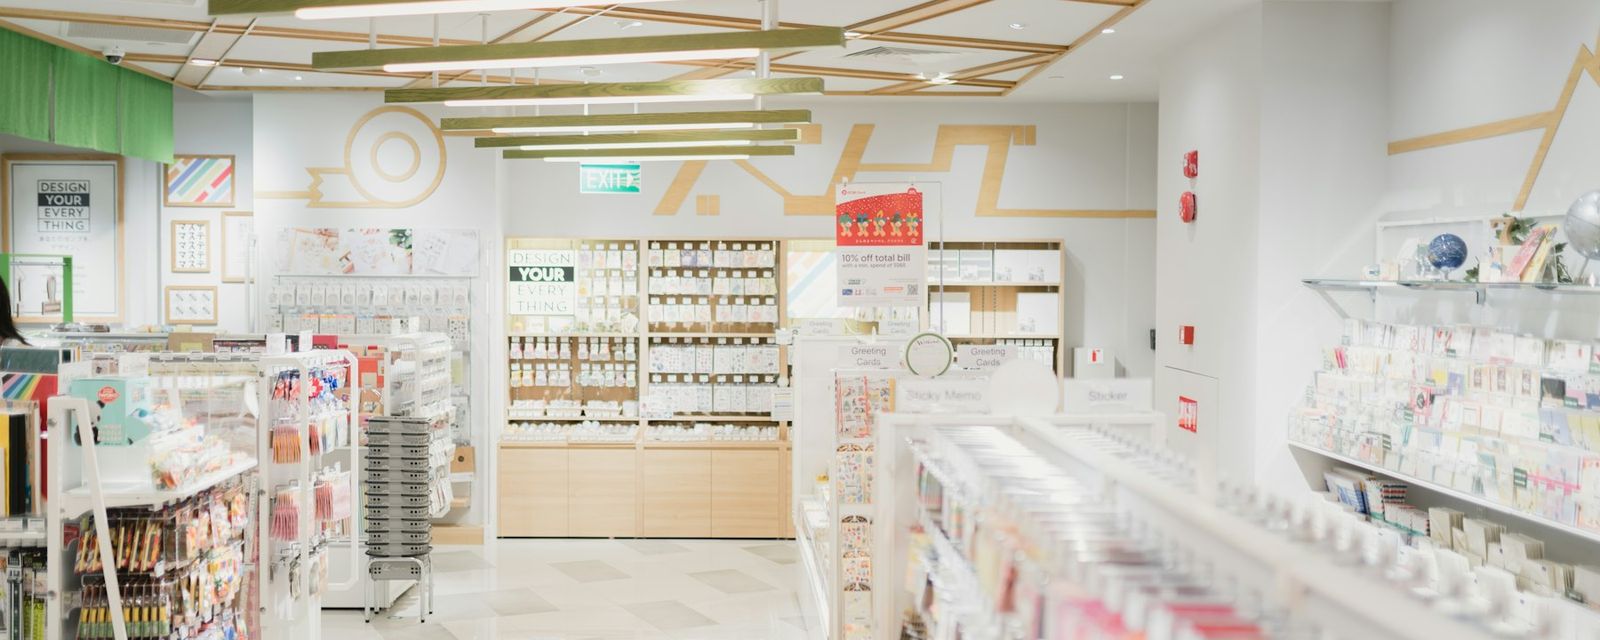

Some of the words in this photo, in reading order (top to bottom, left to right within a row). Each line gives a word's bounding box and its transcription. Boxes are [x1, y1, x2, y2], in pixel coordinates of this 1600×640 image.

[587, 170, 621, 189] EXIT
[41, 182, 87, 192] DESIGN
[45, 194, 82, 206] YOUR
[44, 207, 84, 217] EVERY
[43, 220, 85, 230] THING
[513, 252, 570, 264] DESIGN
[842, 254, 859, 262] 10%
[861, 254, 873, 262] off
[875, 254, 895, 262] total
[897, 253, 911, 262] bill
[518, 267, 565, 281] YOUR
[517, 284, 566, 296] EVERY
[517, 300, 567, 312] THING
[851, 346, 887, 356] Greeting
[970, 347, 1006, 357] Greeting
[856, 358, 881, 366] Cards
[976, 358, 1001, 366] Cards
[906, 390, 941, 402] Sticky
[945, 390, 982, 401] Memo
[1089, 391, 1128, 401] Sticker
